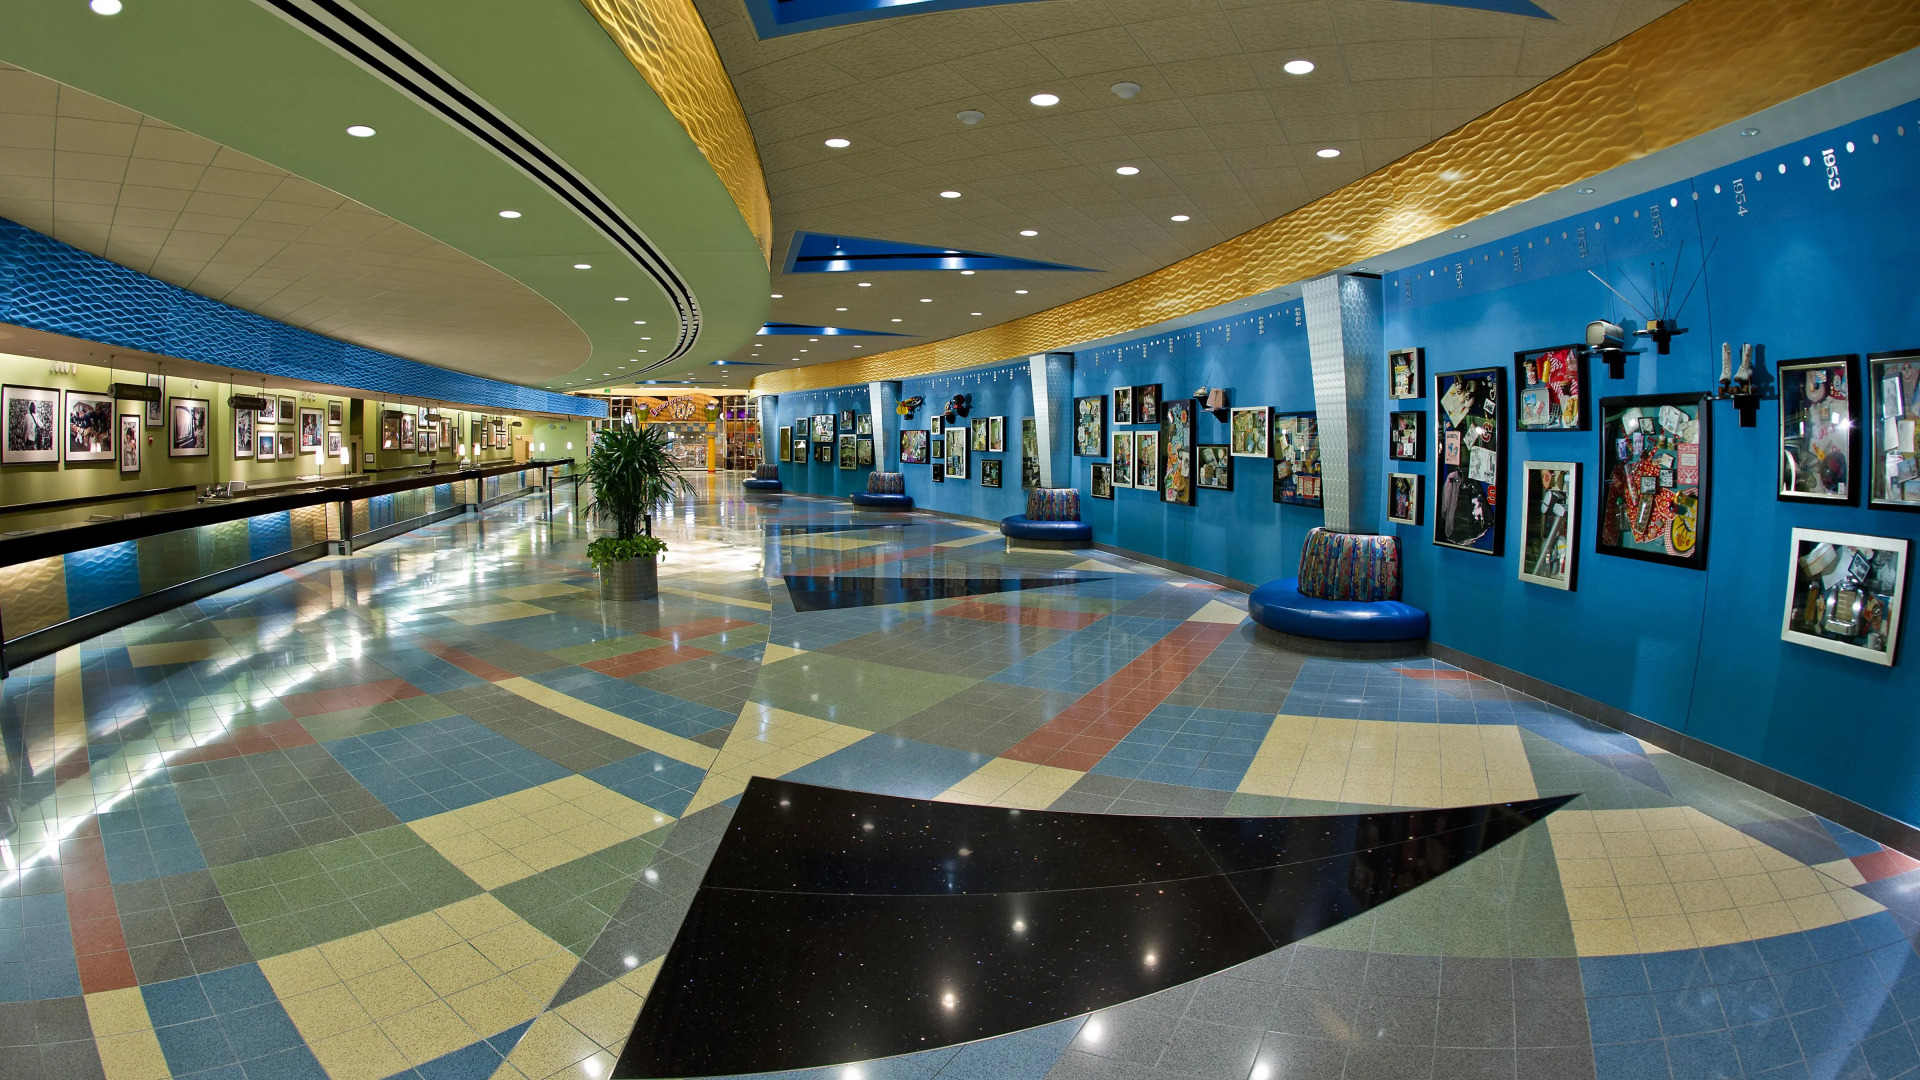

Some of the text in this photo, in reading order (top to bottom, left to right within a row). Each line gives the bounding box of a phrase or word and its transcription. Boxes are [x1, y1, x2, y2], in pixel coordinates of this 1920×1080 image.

[1821, 148, 1841, 191] 1953
[1732, 177, 1749, 217] 1954
[1649, 204, 1664, 239] 1955
[1512, 246, 1523, 273] 1957
[1577, 227, 1589, 259] 1956
[1454, 262, 1464, 290] 1958
